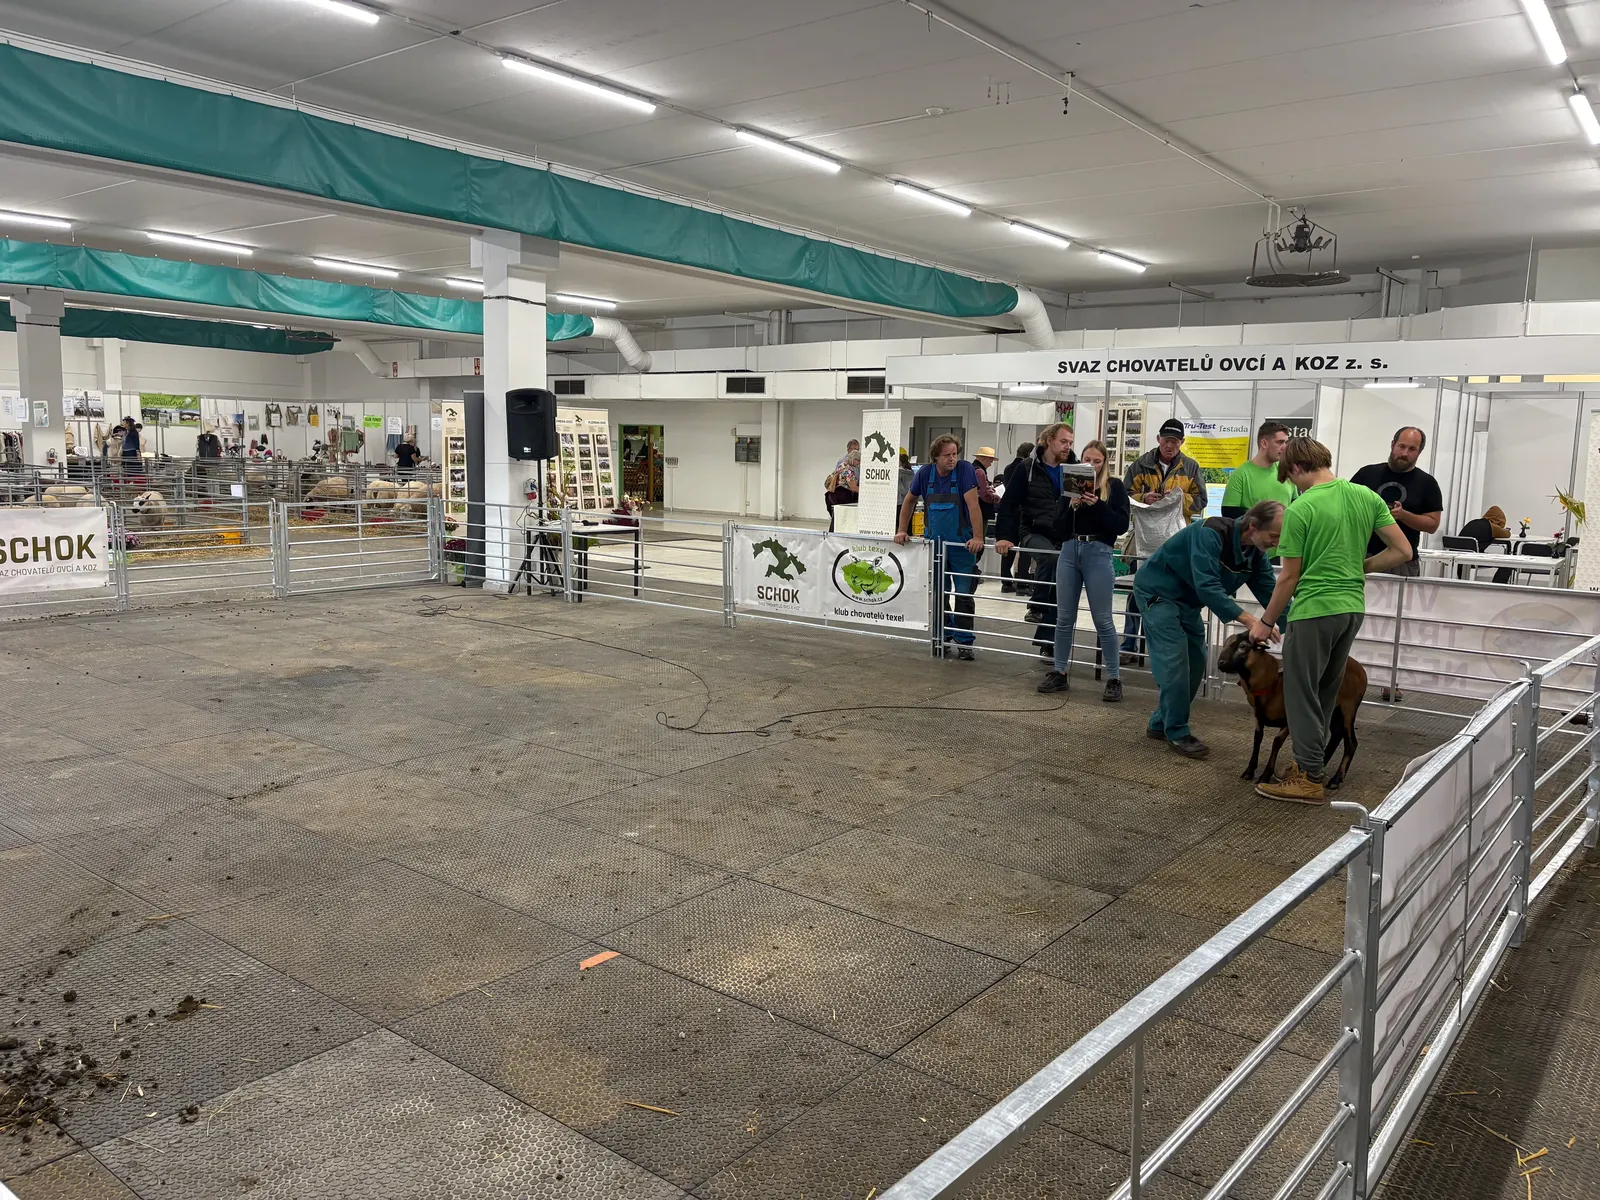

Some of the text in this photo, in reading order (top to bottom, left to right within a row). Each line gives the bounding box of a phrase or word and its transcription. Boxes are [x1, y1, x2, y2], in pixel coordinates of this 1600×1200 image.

[1058, 353, 1388, 374] SVAZ CHOVATELŮ OVCÍ A KOZ z. s.
[1184, 422, 1217, 430] Tru-Test
[1219, 424, 1249, 433] festada
[865, 468, 891, 481] SCHOK
[852, 544, 887, 554] klub texel
[11, 564, 55, 577] CHOVATELŮ
[56, 563, 74, 574] OVCÍ
[83, 564, 98, 572] KOZ
[757, 585, 800, 604] SCHOK
[834, 607, 905, 622] klub chovatelů texel
